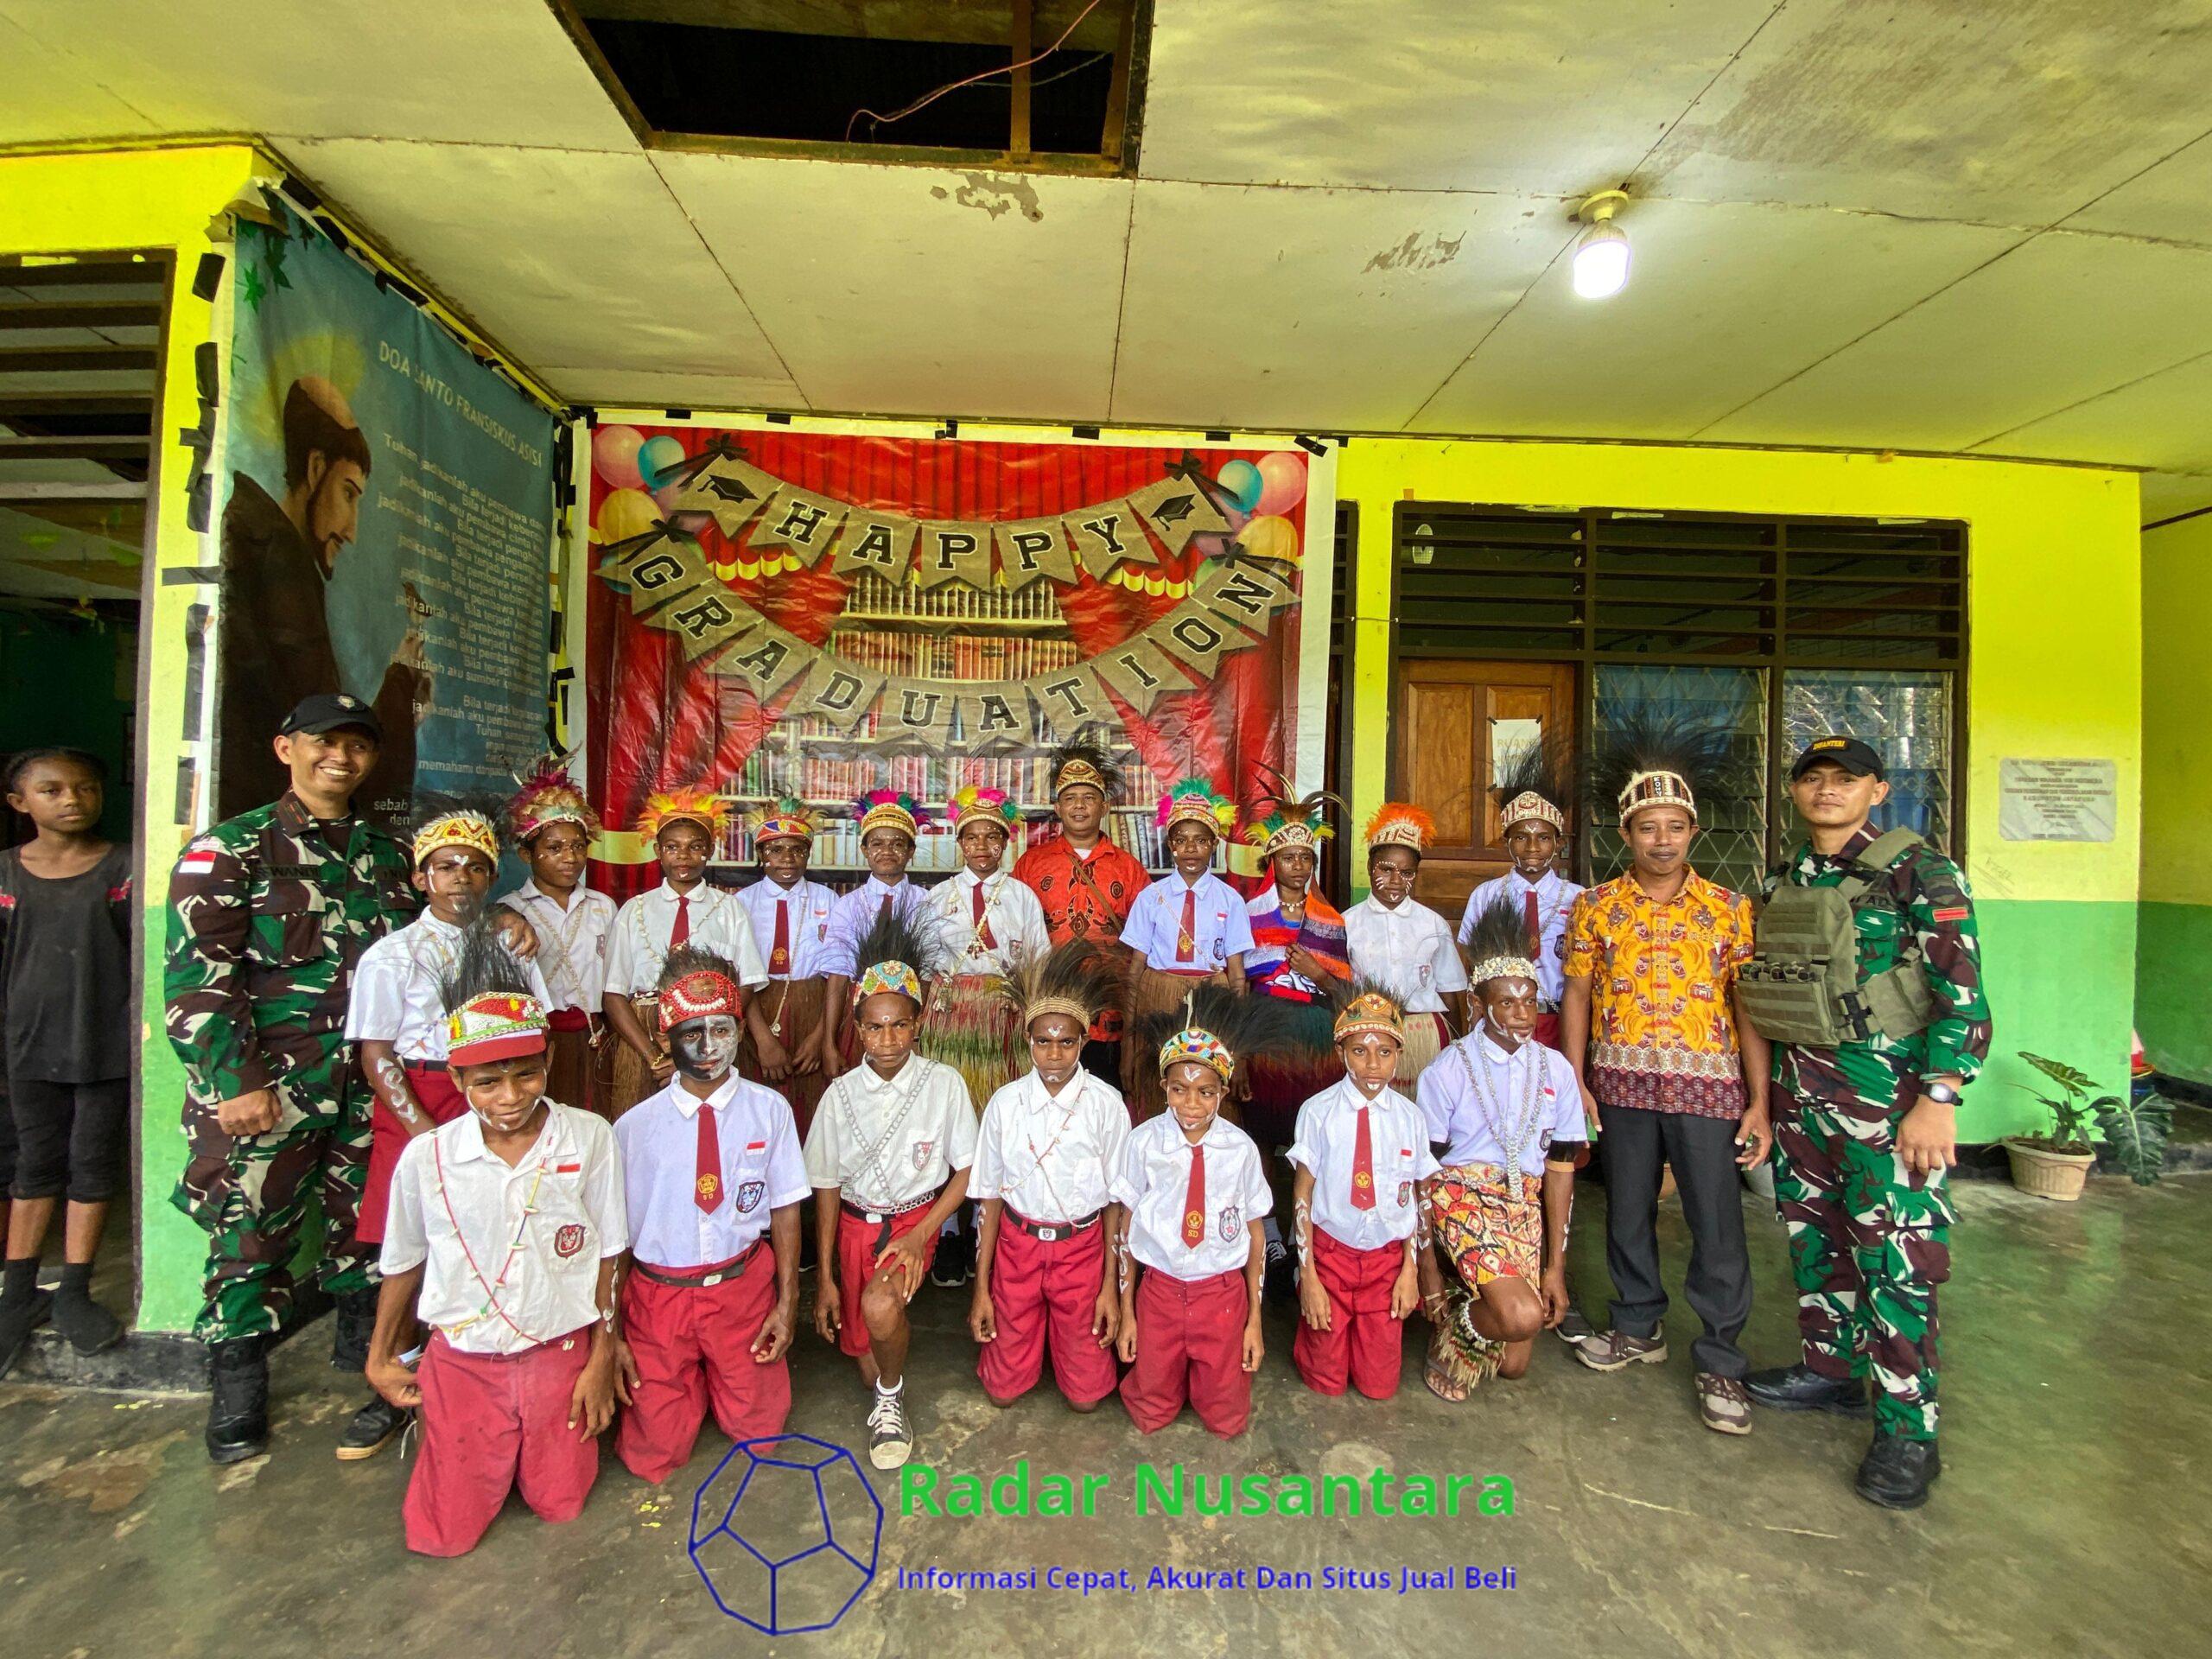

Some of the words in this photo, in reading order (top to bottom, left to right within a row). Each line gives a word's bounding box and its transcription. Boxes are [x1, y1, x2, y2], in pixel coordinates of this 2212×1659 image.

[378, 340, 410, 378] DOA
[456, 394, 517, 452] FRANSISKUS
[773, 499, 1127, 573] HAPPY
[631, 554, 1277, 733] GRADUATION
[412, 698, 464, 721] jadkanlah
[373, 798, 409, 811] sebab
[1187, 1230, 1199, 1238] SD
